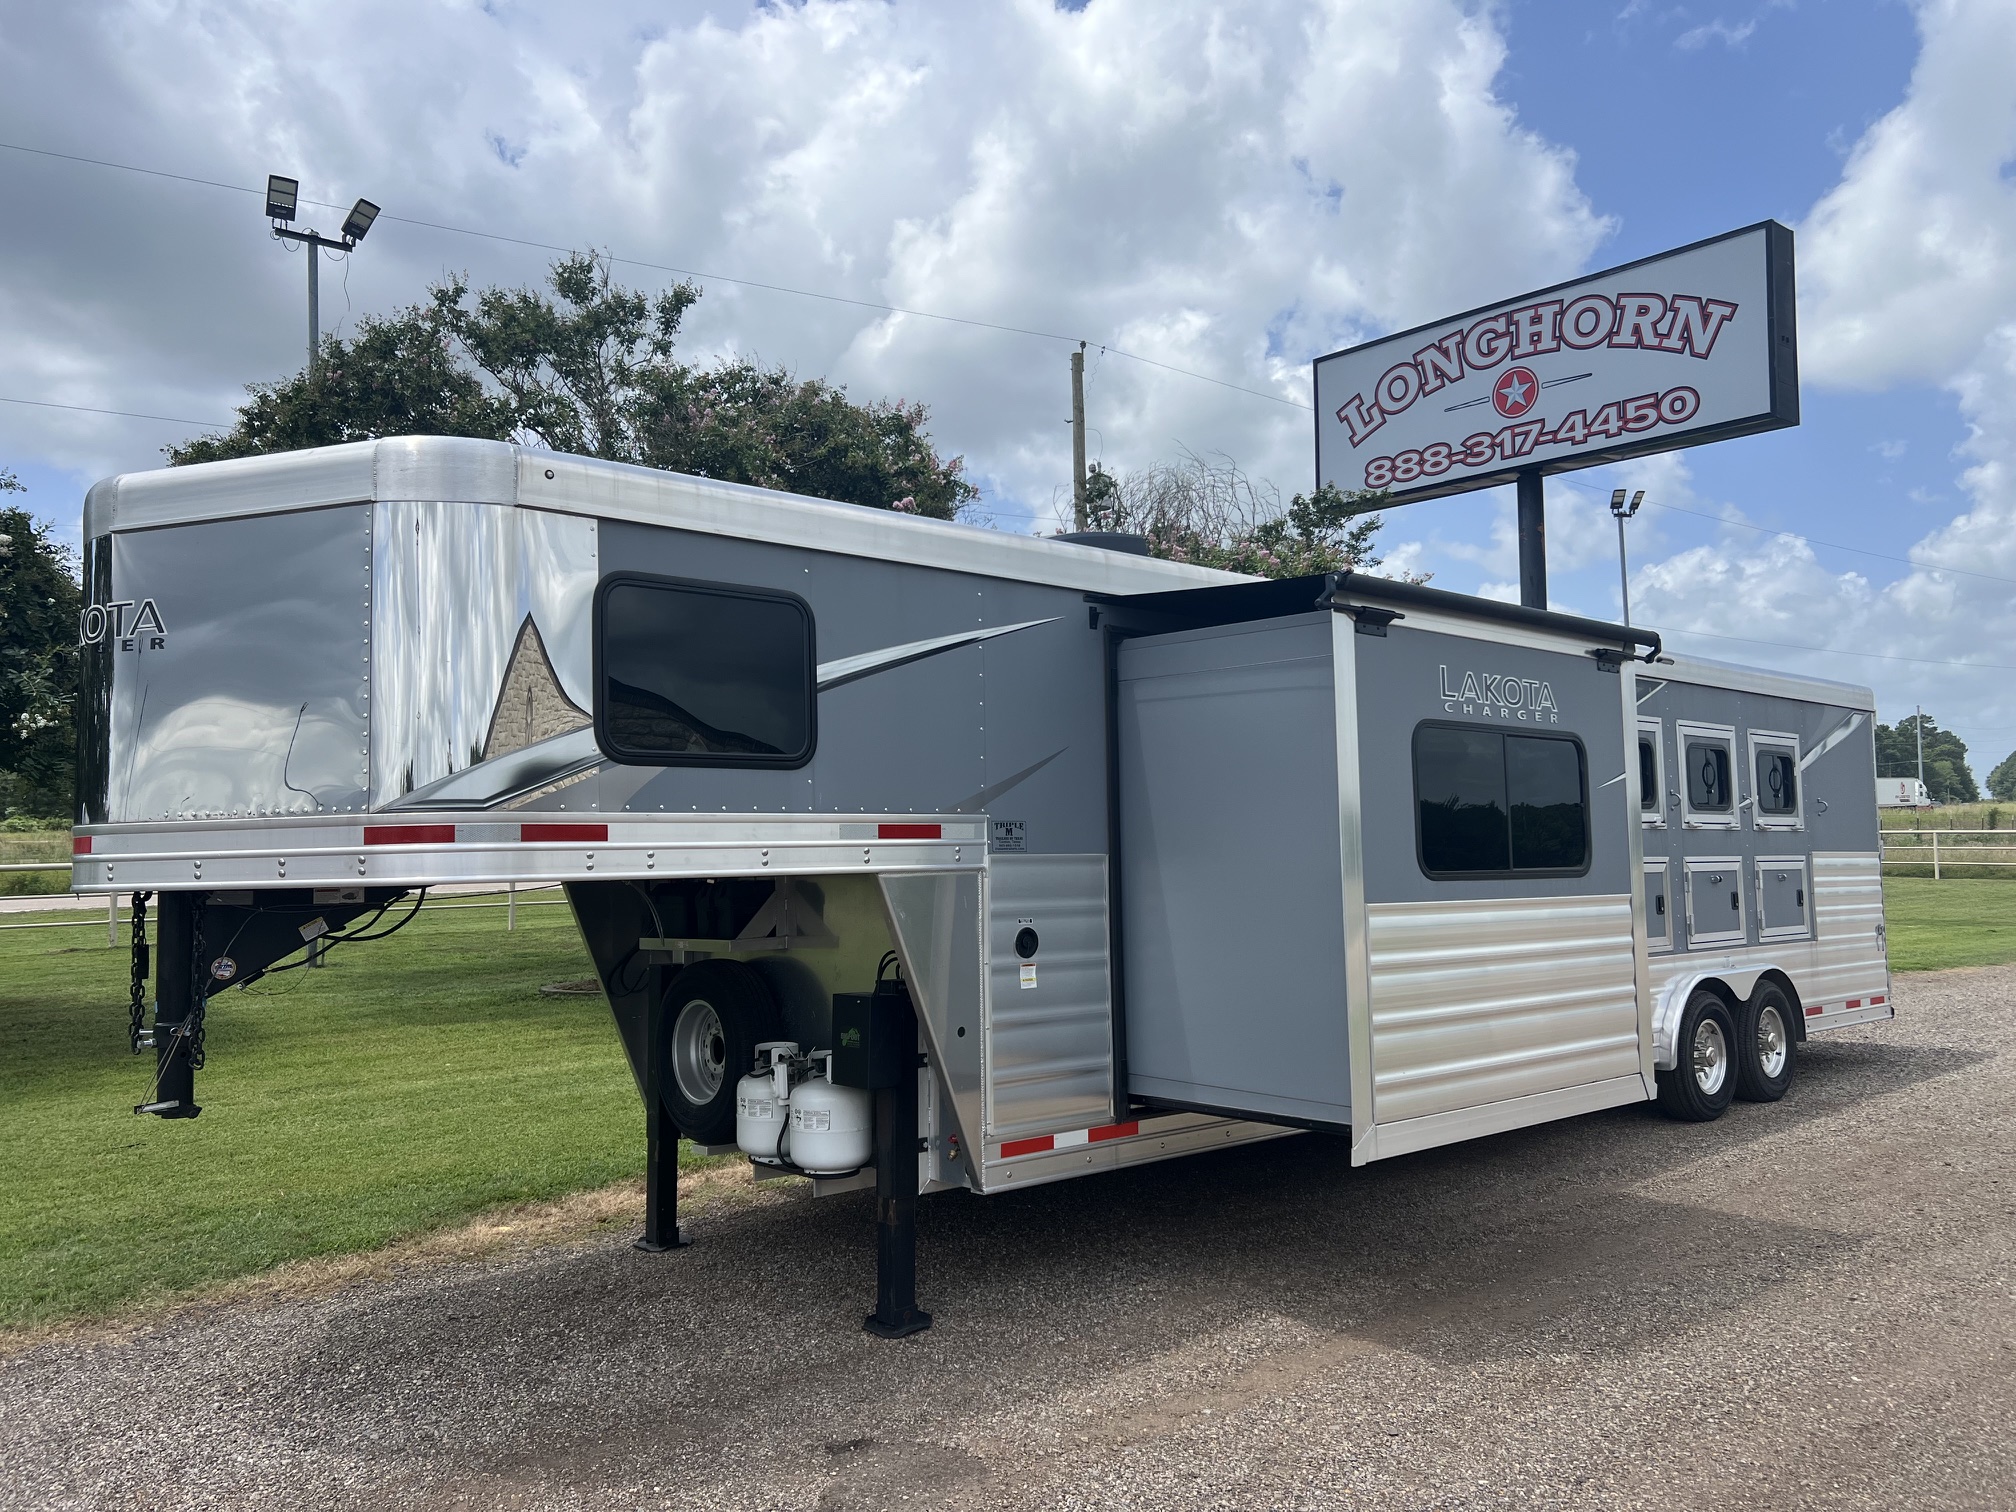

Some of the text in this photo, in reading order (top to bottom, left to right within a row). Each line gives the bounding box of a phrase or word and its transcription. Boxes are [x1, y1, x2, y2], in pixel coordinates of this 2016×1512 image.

[1336, 292, 1739, 448] LONGHORN
[1365, 386, 1701, 489] 888-317-4450
[1439, 664, 1559, 713] LAKOTA
[1444, 702, 1558, 724] CHARGER
[1005, 827, 1014, 836] M
